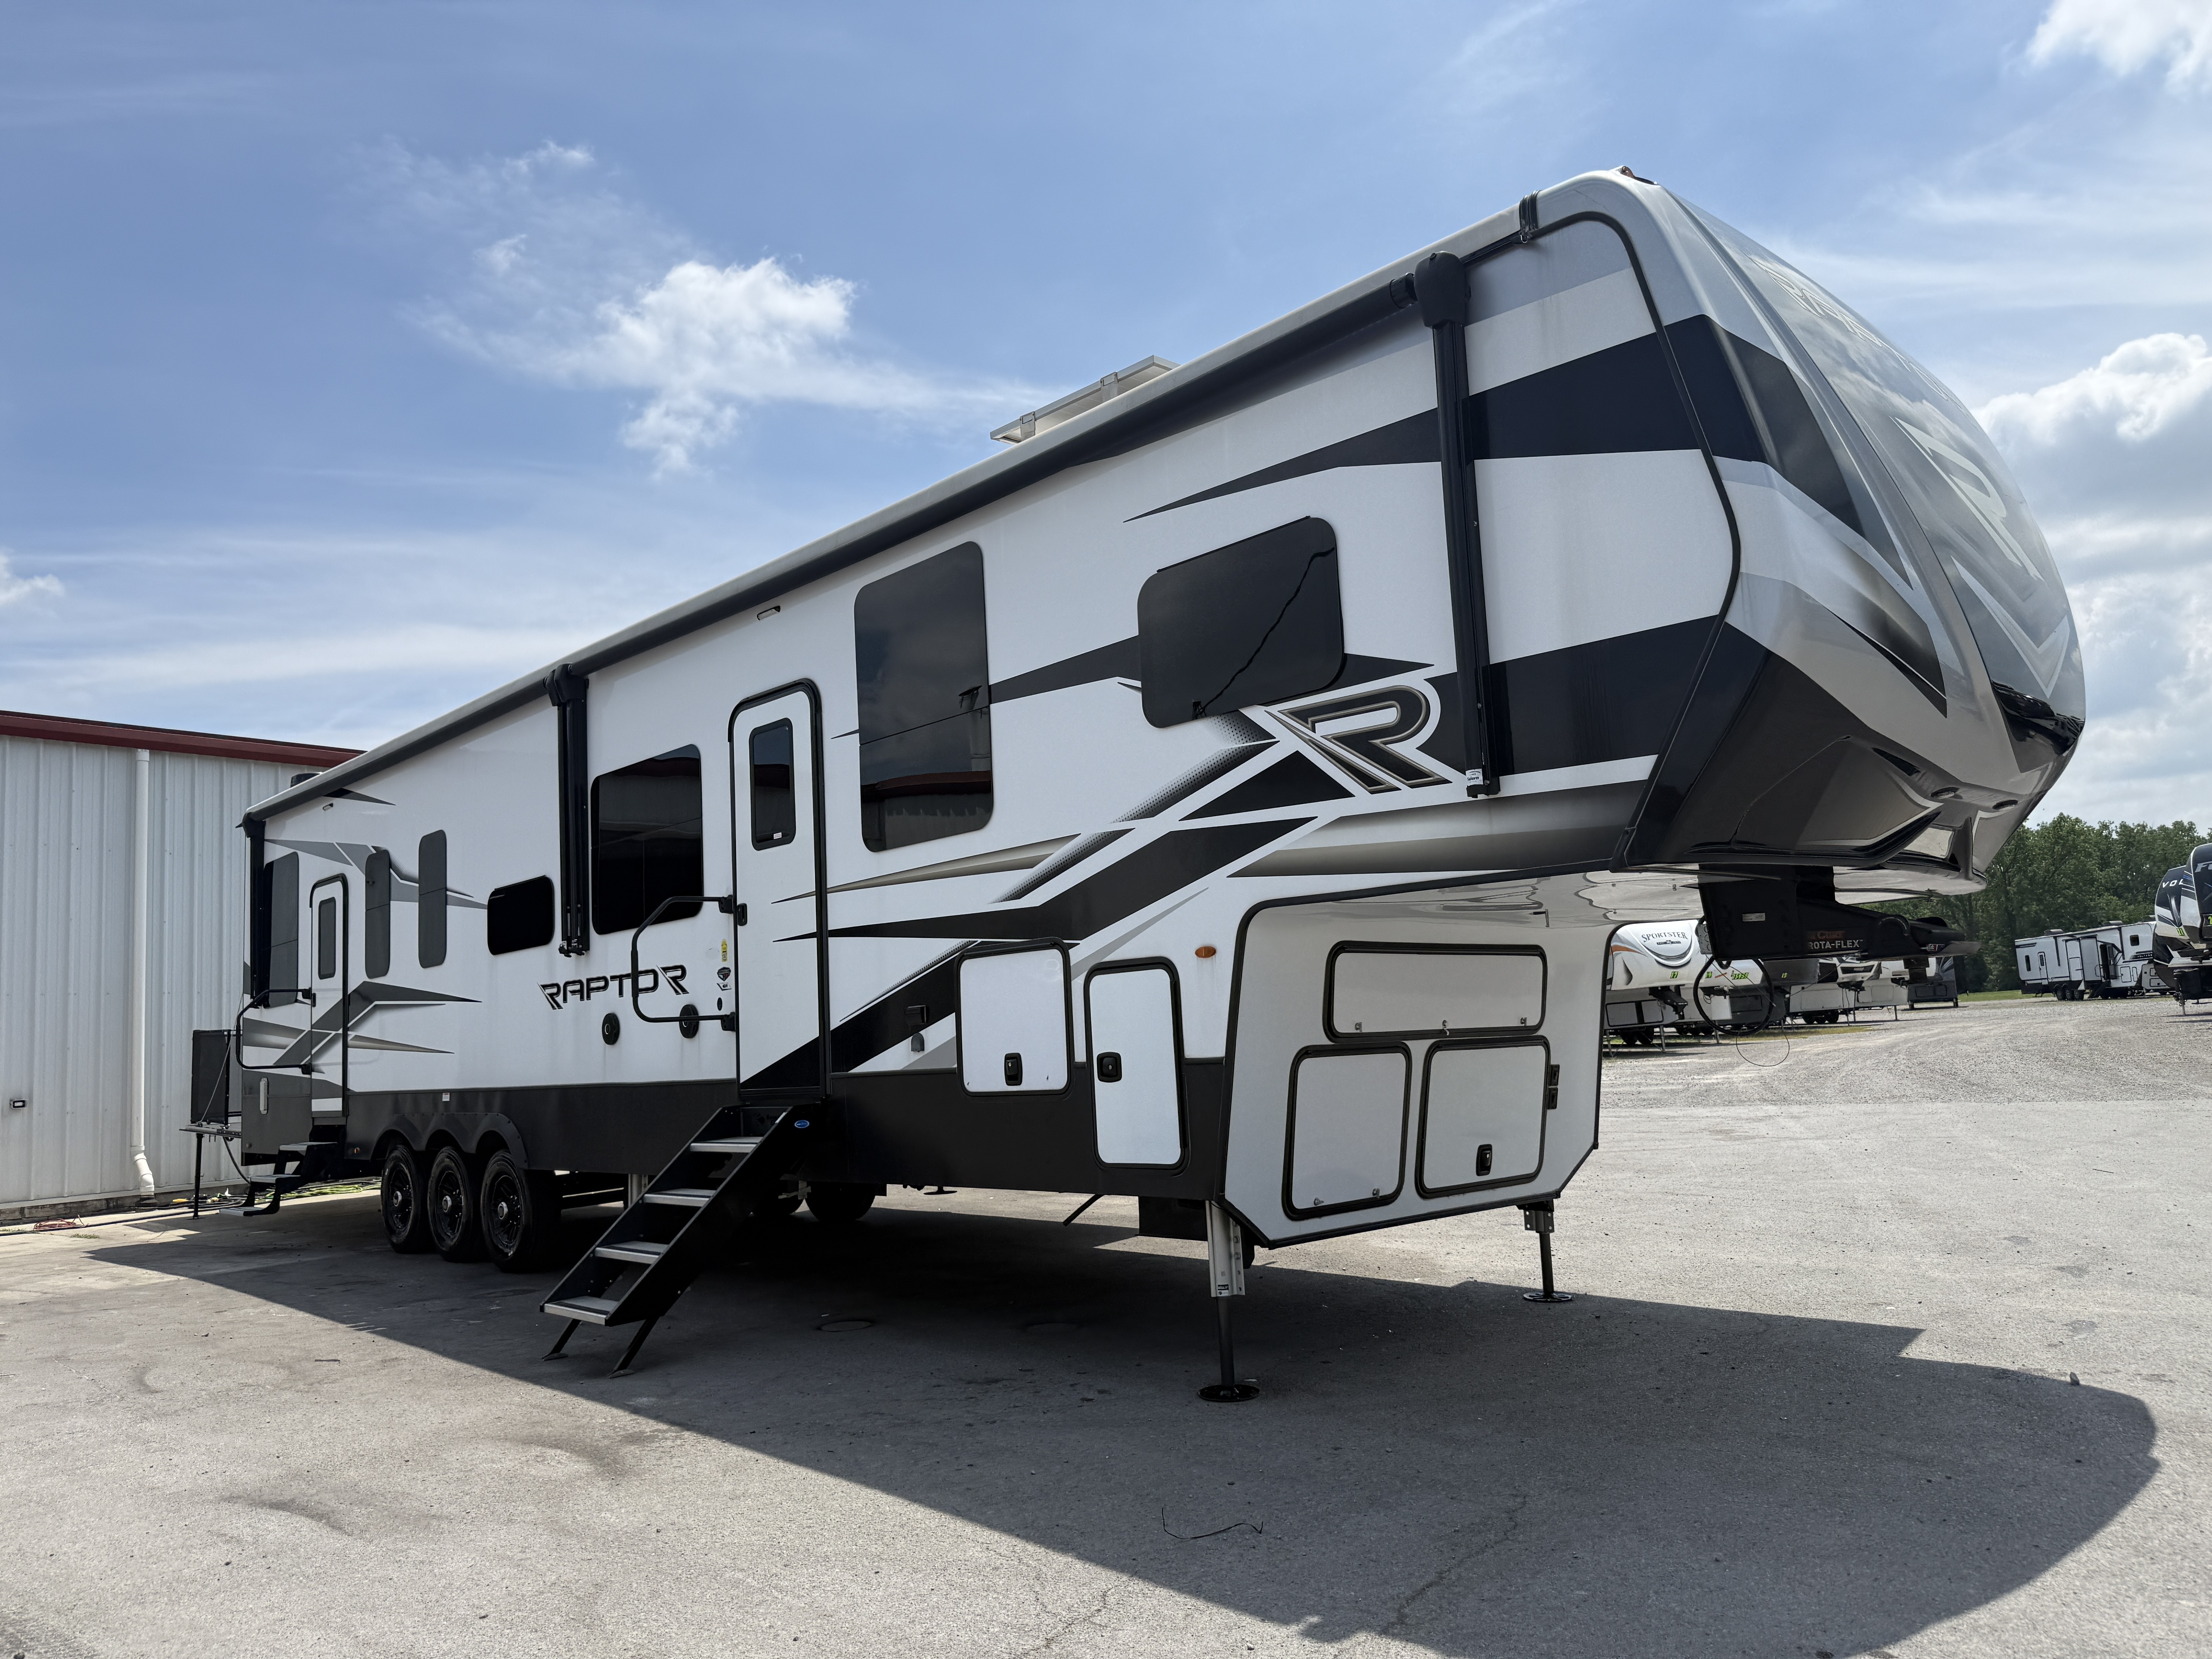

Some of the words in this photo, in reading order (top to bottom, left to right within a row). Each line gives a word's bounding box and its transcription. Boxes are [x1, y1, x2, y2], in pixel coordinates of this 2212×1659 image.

[1264, 684, 1453, 795] R
[1642, 932, 1688, 943] SPORTSTER
[537, 964, 689, 1010] RAPTOR
